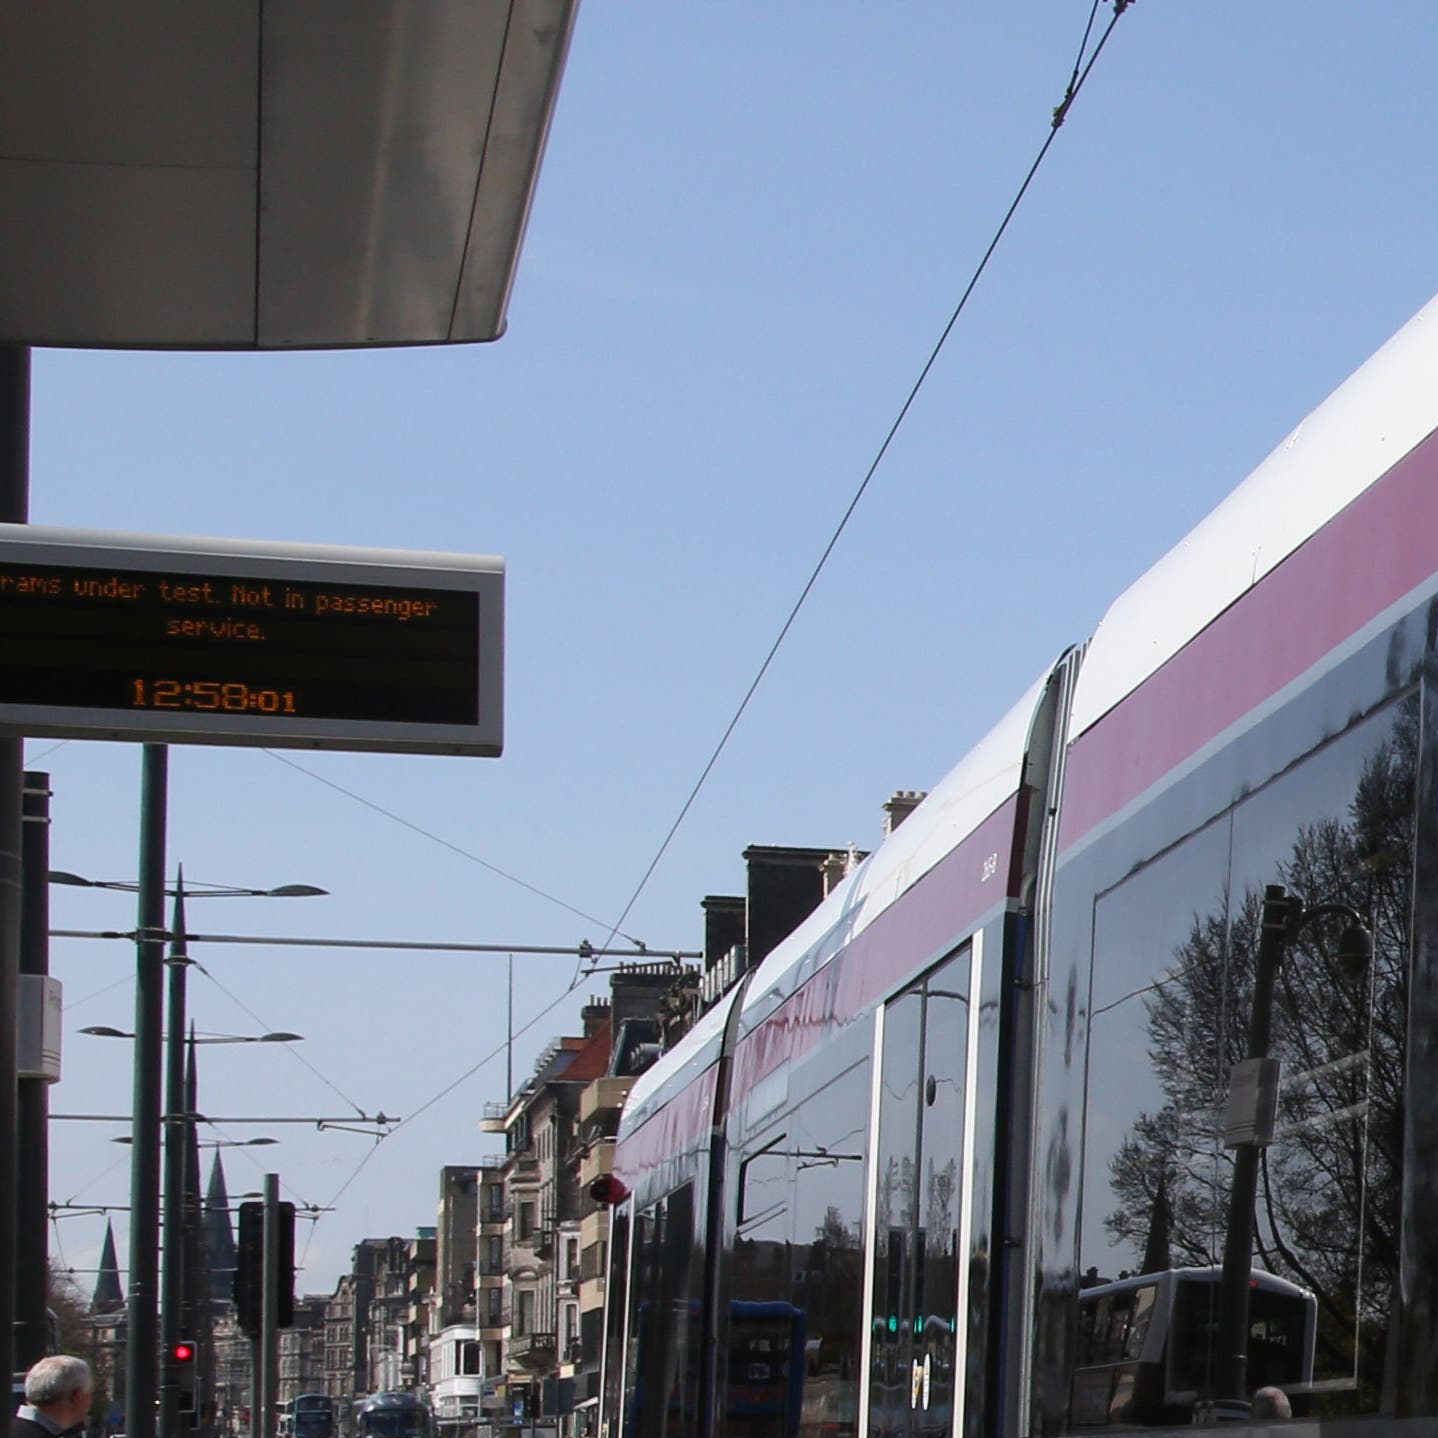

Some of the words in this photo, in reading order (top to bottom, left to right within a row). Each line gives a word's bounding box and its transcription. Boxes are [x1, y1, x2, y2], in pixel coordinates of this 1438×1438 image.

[73, 576, 147, 600] under
[159, 580, 221, 605] test.
[231, 584, 274, 607] Not
[285, 587, 305, 609] in
[315, 593, 438, 621] passenger
[166, 616, 266, 641] service.
[132, 678, 297, 713] 12:58:01
